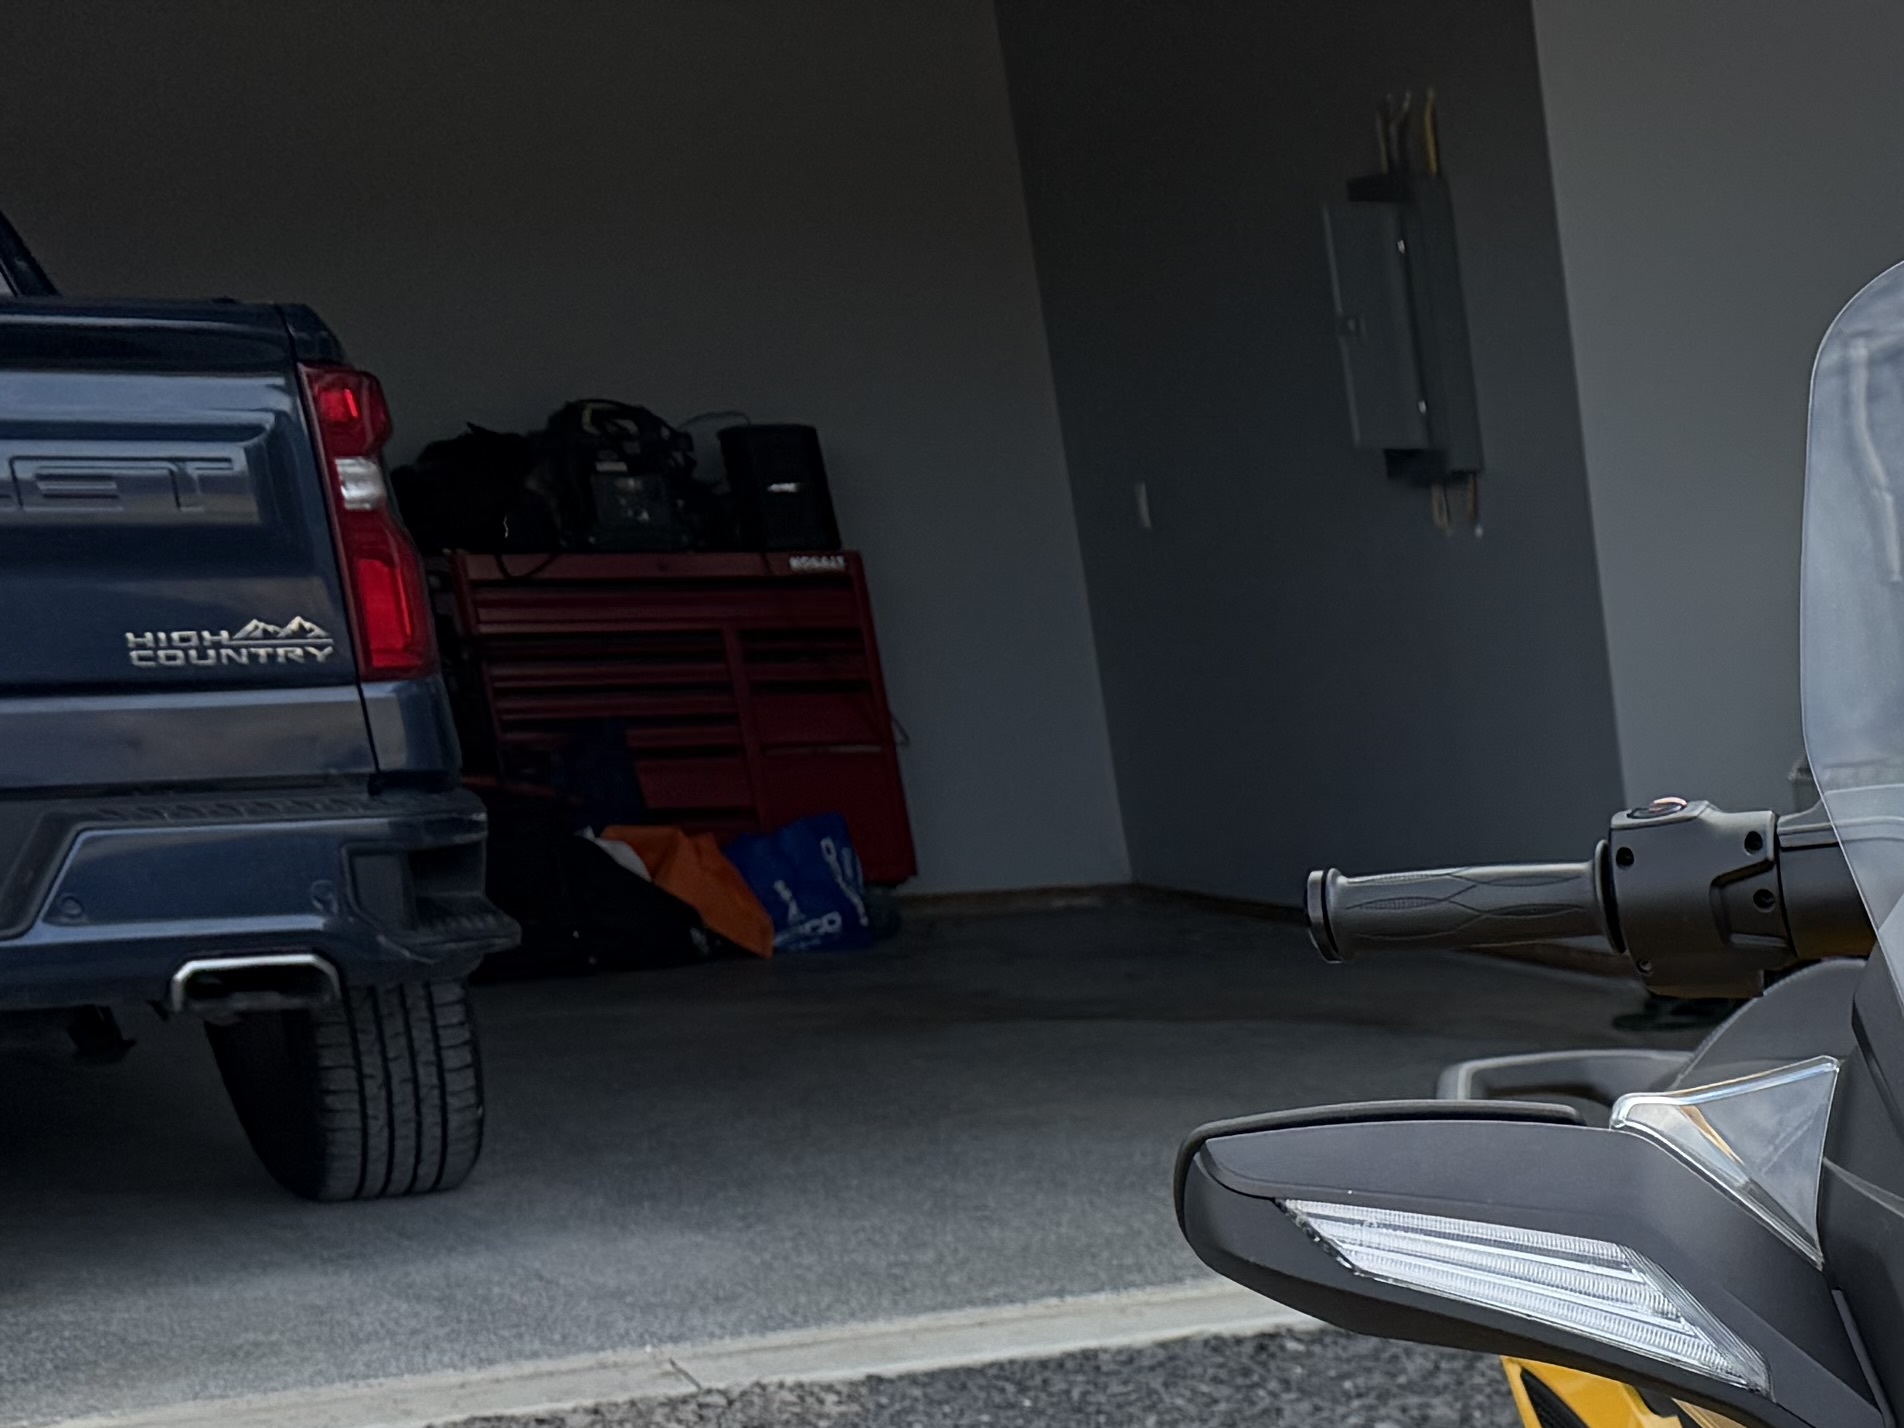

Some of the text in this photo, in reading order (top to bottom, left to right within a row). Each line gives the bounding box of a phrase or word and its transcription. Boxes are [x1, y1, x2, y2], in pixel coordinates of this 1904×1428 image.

[0, 455, 234, 513] ET
[125, 630, 230, 648] HIGH
[129, 646, 334, 667] COUNTRY
